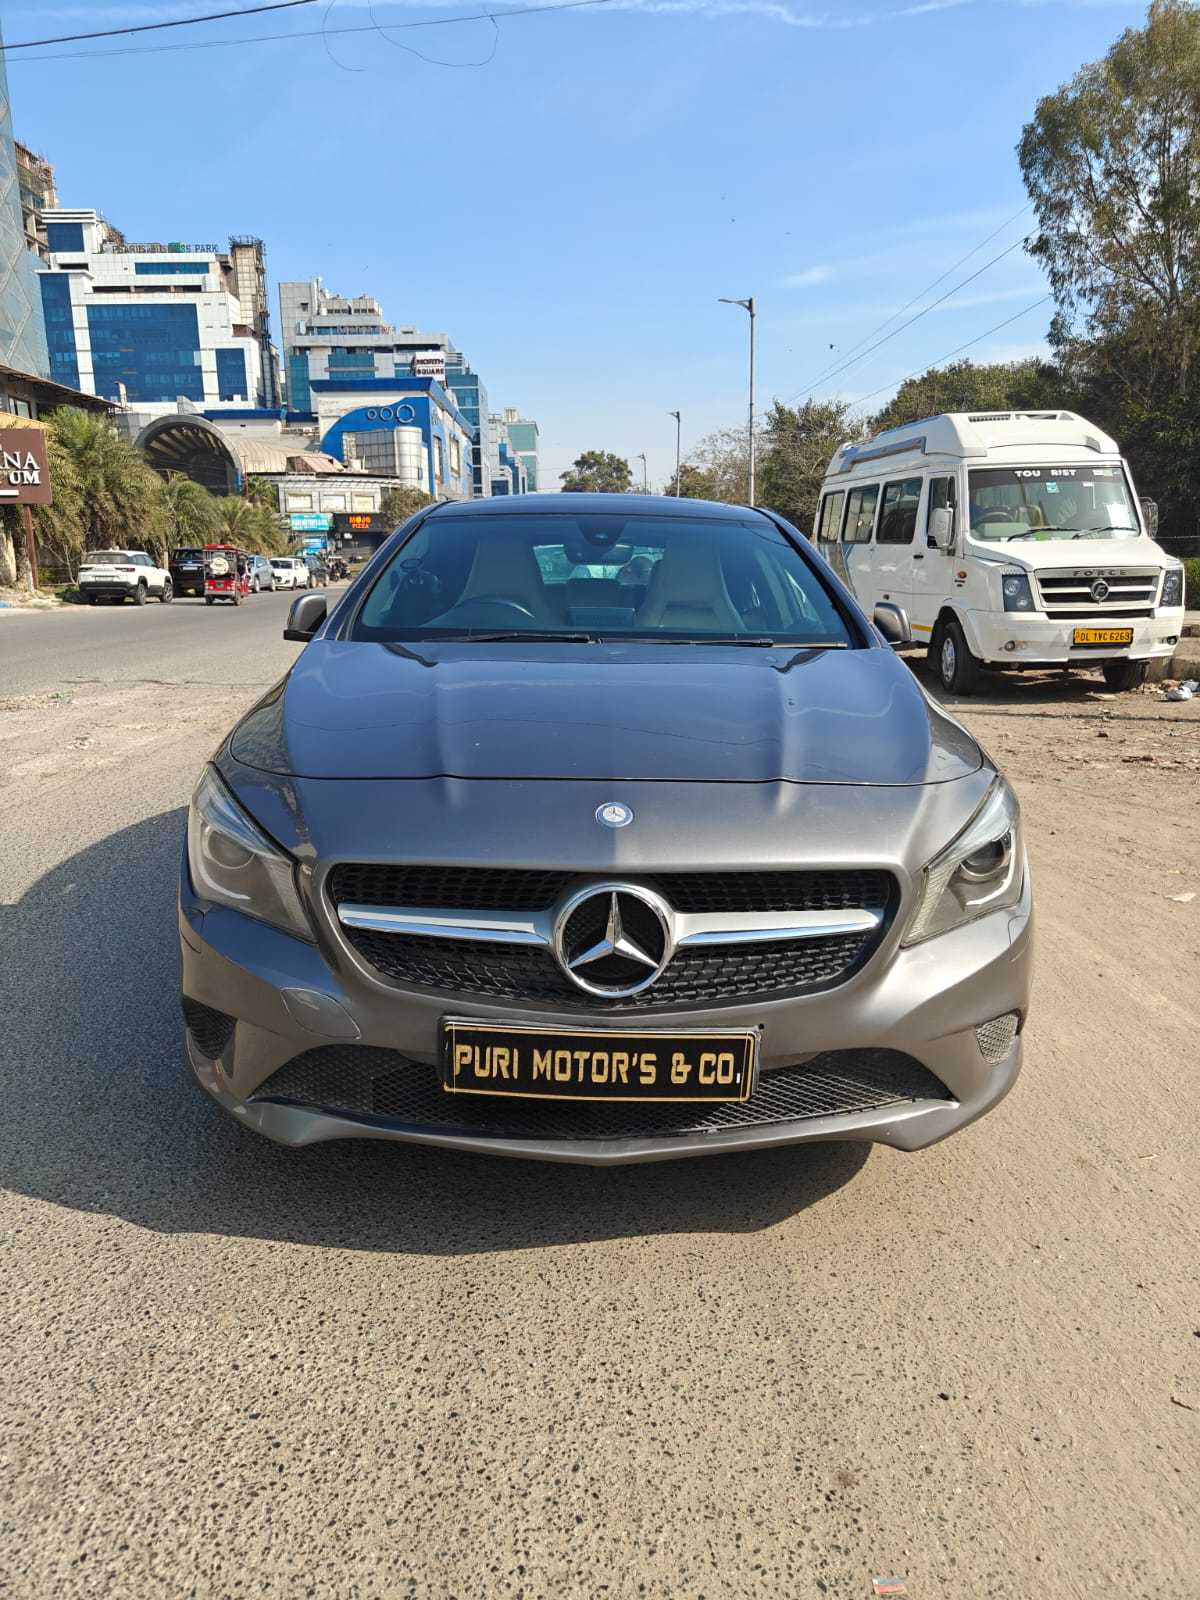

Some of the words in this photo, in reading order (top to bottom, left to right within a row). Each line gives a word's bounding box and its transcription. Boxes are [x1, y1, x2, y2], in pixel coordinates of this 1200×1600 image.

[194, 244, 218, 253] PARK
[349, 516, 372, 524] MOJO
[1080, 632, 1090, 641] DL
[454, 1044, 519, 1079] PURI
[532, 1049, 657, 1085] MOTOR'S
[670, 1052, 692, 1084] &
